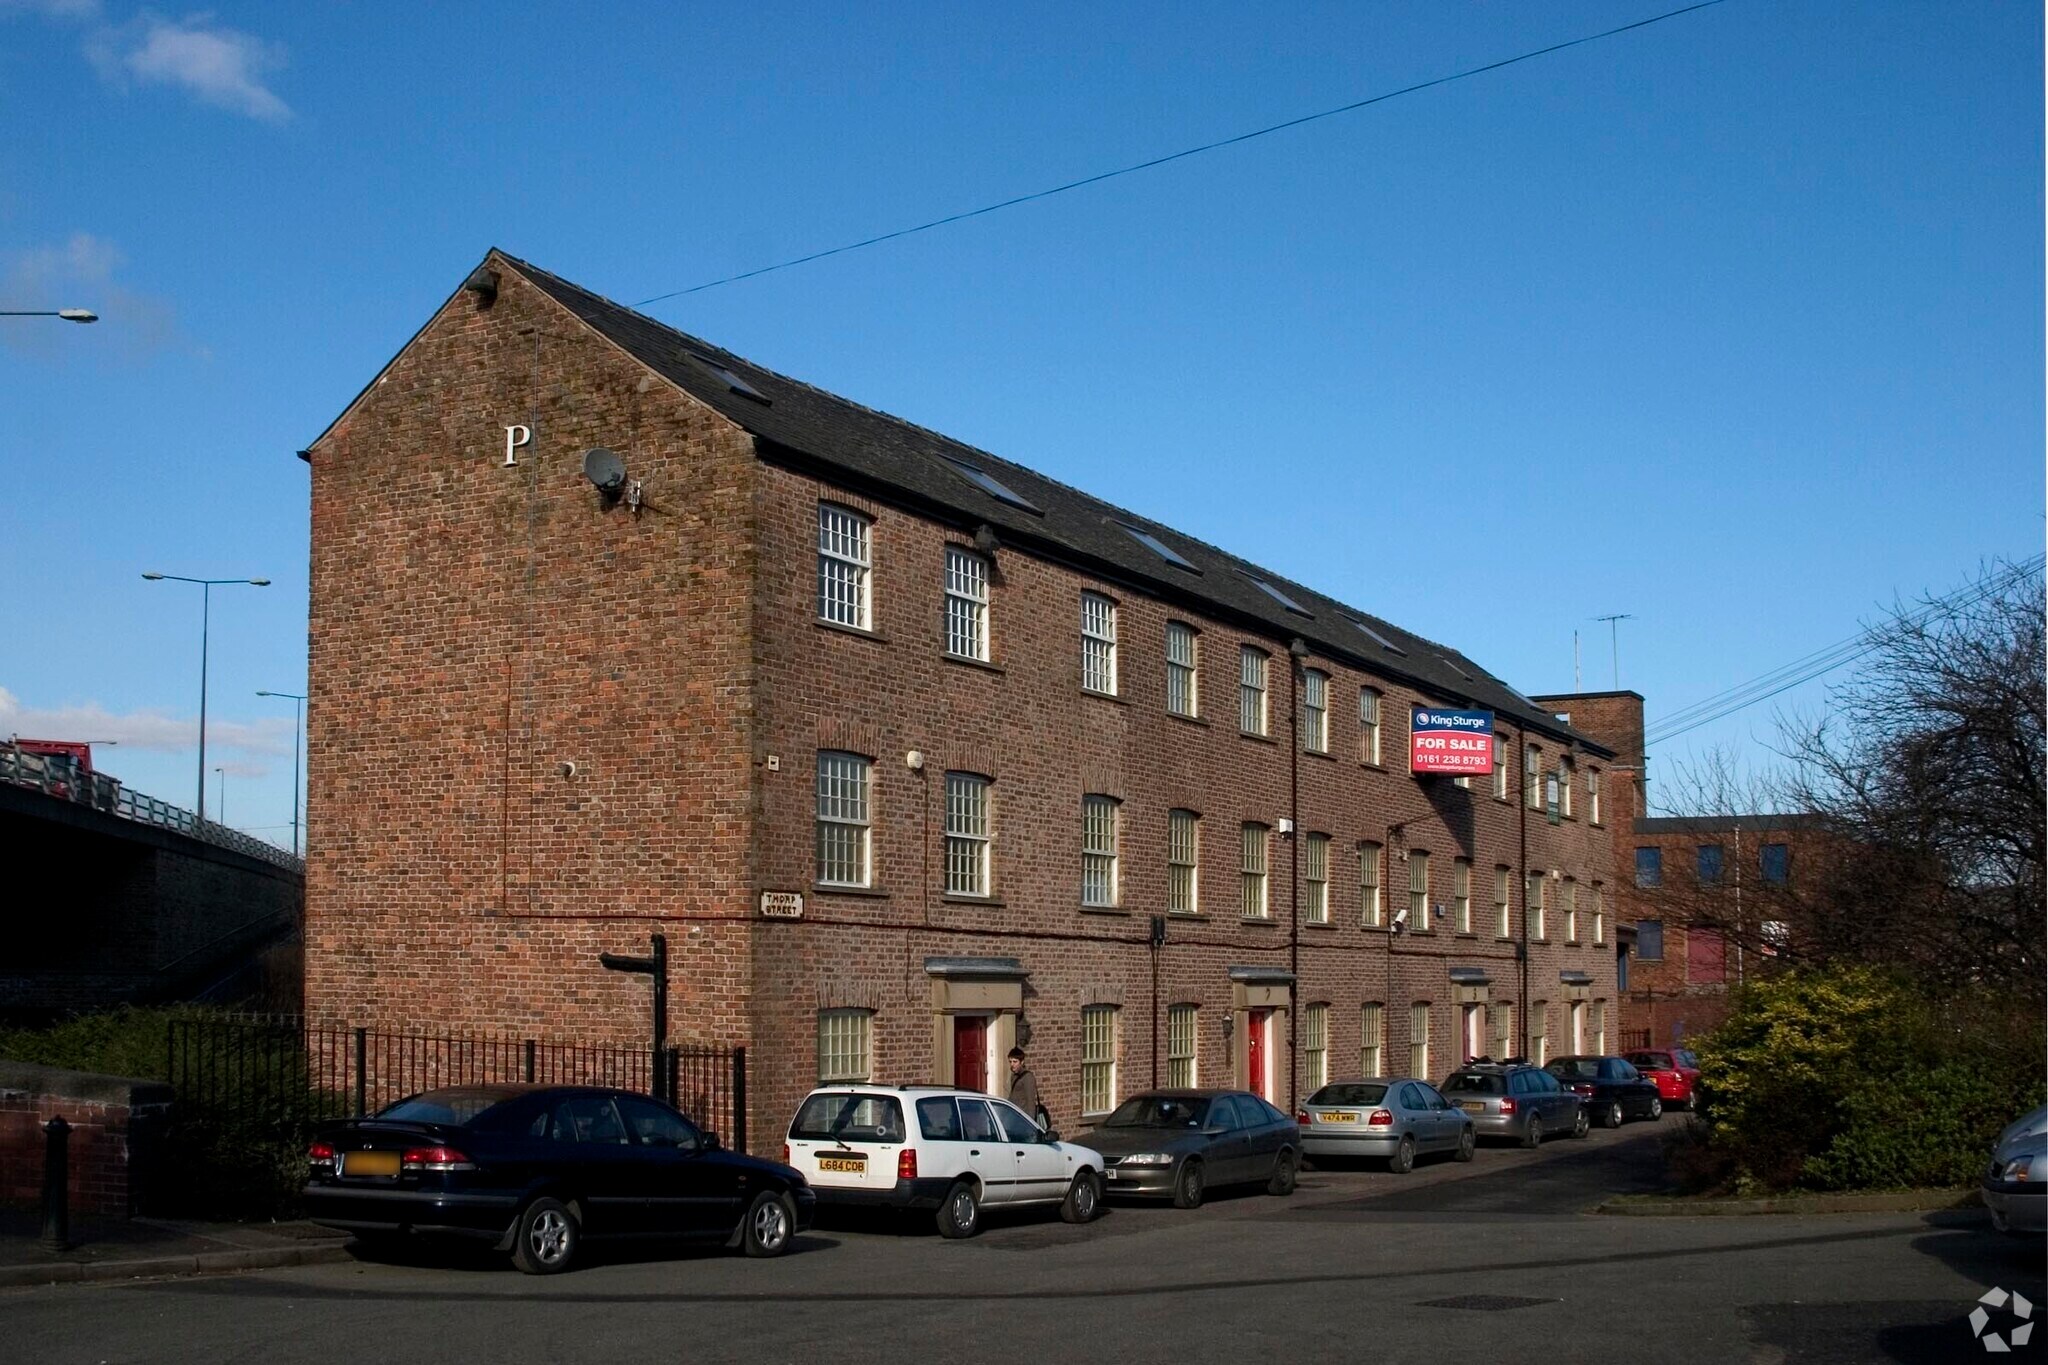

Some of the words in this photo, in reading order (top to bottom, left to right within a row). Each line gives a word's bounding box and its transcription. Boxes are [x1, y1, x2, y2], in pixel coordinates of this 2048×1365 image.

[503, 424, 531, 465] P
[1430, 715, 1452, 728] King
[1453, 716, 1485, 729] Sturge
[1416, 737, 1446, 750] FOR
[1449, 738, 1487, 751] SALE
[1416, 754, 1440, 764] 0161
[1442, 755, 1461, 765] 236
[1462, 756, 1487, 766] 8793
[766, 905, 797, 915] STREET
[820, 1160, 843, 1172] L684
